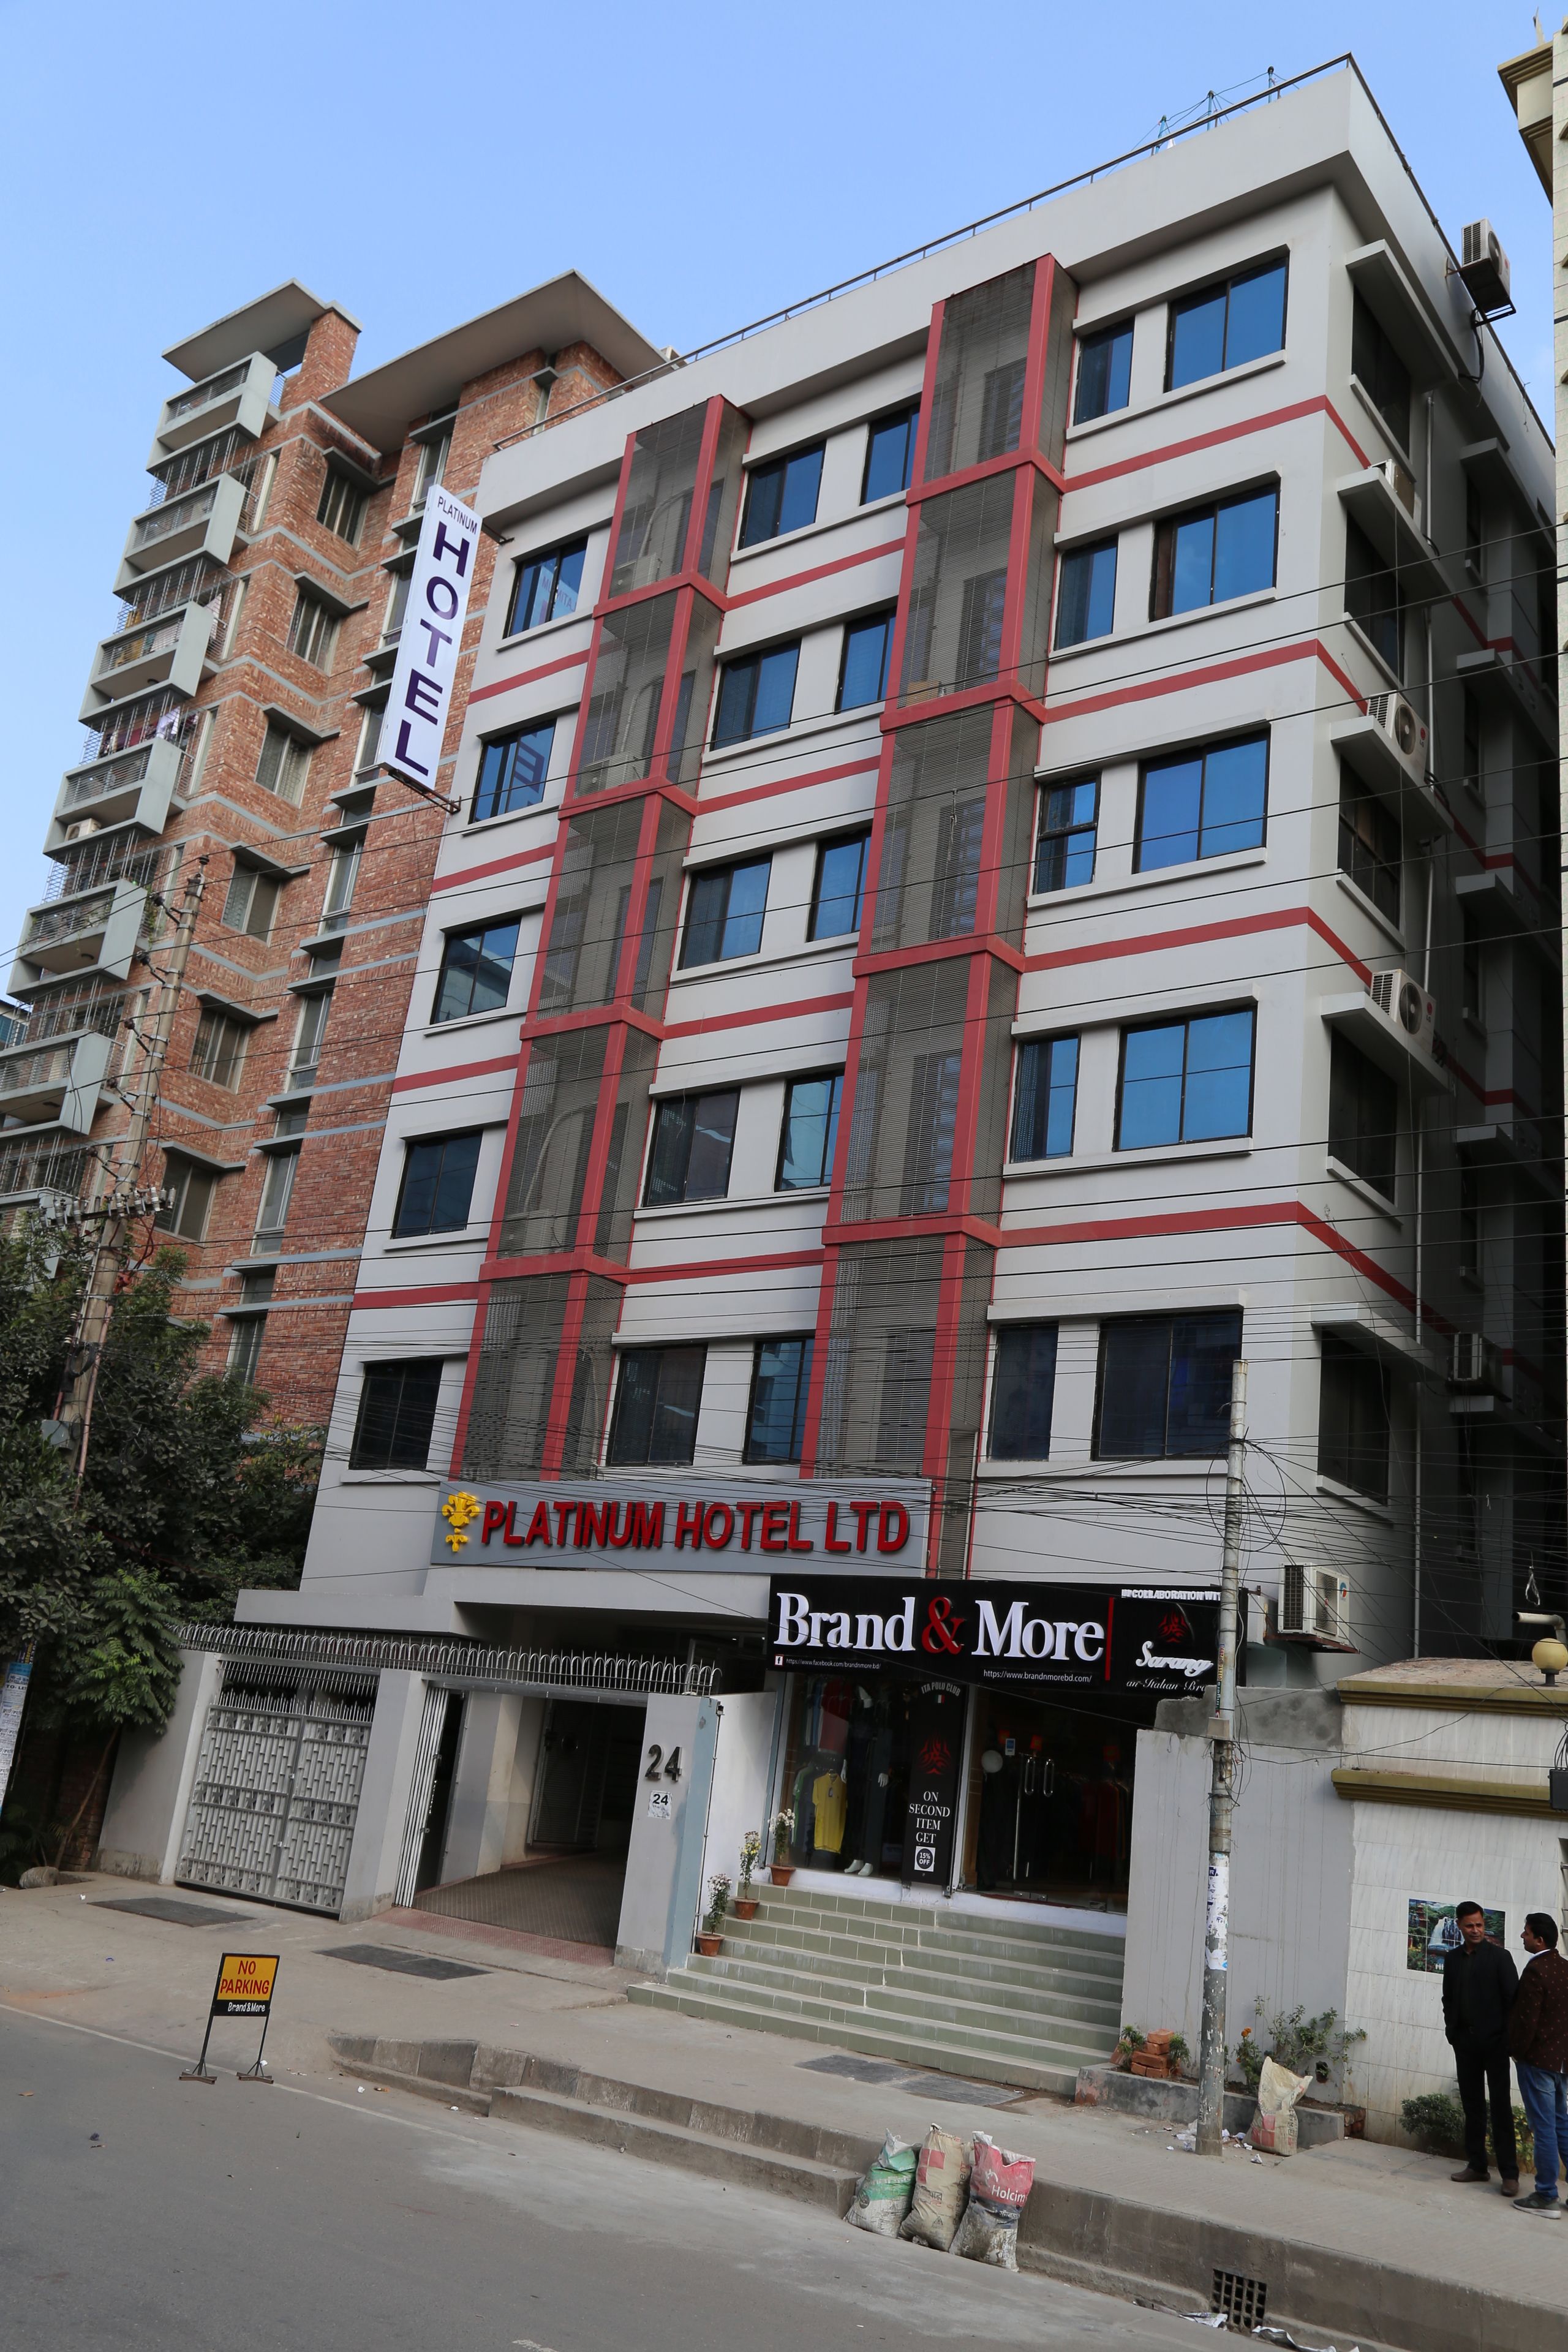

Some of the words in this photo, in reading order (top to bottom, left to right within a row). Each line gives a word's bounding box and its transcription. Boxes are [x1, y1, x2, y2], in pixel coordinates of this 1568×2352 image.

[437, 496, 477, 535] PLATINUM
[394, 521, 470, 777] HOTEL
[481, 1500, 664, 1548] PLATINUM
[674, 1500, 813, 1551] HOTEL
[824, 1500, 911, 1552] LTD
[1132, 1589, 1204, 1600] COLLABORATION
[1204, 1591, 1221, 1601] WIT
[774, 1593, 916, 1651] Brand
[921, 1596, 965, 1654] &
[971, 1600, 1104, 1662] More
[1136, 1640, 1214, 1677] Sarang
[984, 1669, 1092, 1683] https://www.brandnmorebd.com/
[946, 1683, 961, 1697] CLUB
[644, 1744, 682, 1782] 24
[652, 1793, 669, 1806] 24
[923, 1790, 939, 1803] ON
[909, 1803, 951, 1818] SECOND
[916, 1817, 941, 1831] ITEM
[916, 1831, 937, 1844] GET
[238, 1960, 257, 1975] NO
[220, 1978, 270, 1995] PARKING
[991, 2184, 1026, 2203] Holcim
